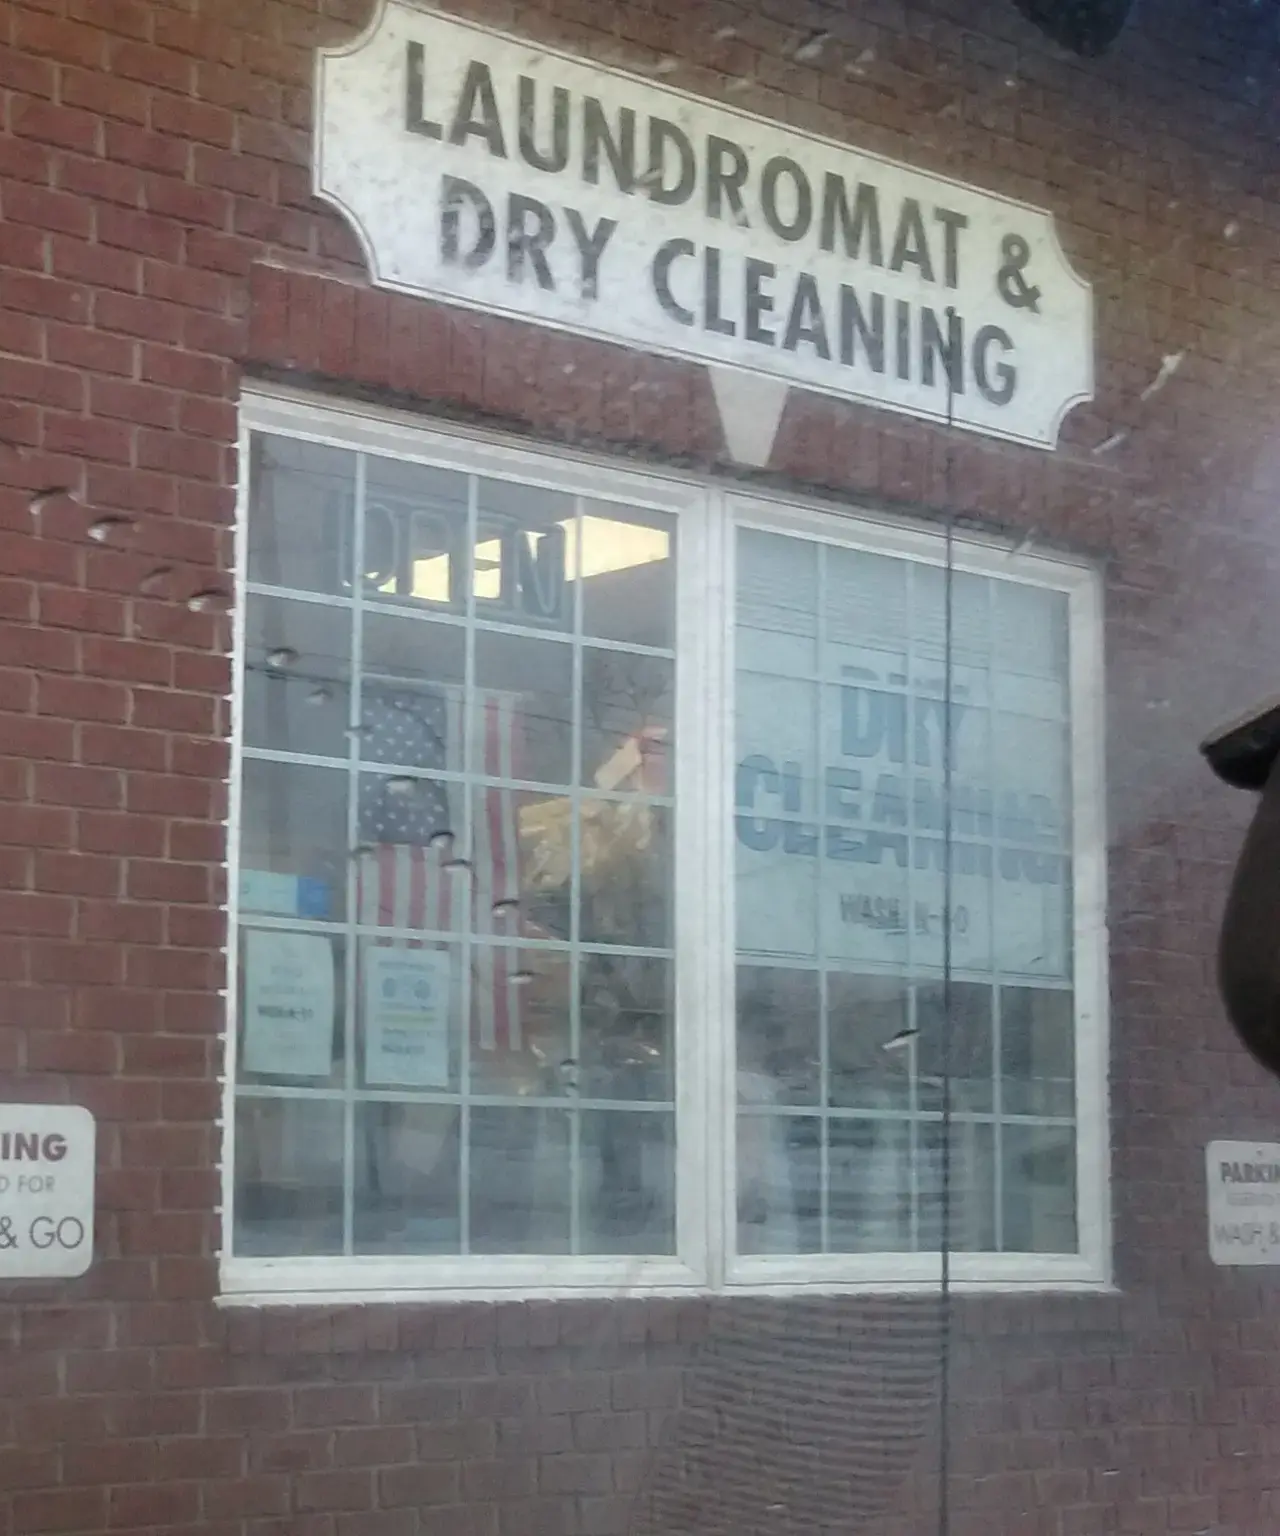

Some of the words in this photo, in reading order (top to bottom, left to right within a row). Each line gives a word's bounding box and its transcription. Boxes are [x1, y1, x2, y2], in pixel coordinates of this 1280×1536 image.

[406, 40, 969, 289] LAUNDROMAT
[995, 232, 1042, 315] &
[439, 174, 618, 300] DRY
[652, 237, 1018, 407] CLEANING
[17, 1174, 56, 1194] FOR
[29, 1215, 85, 1249] GO
